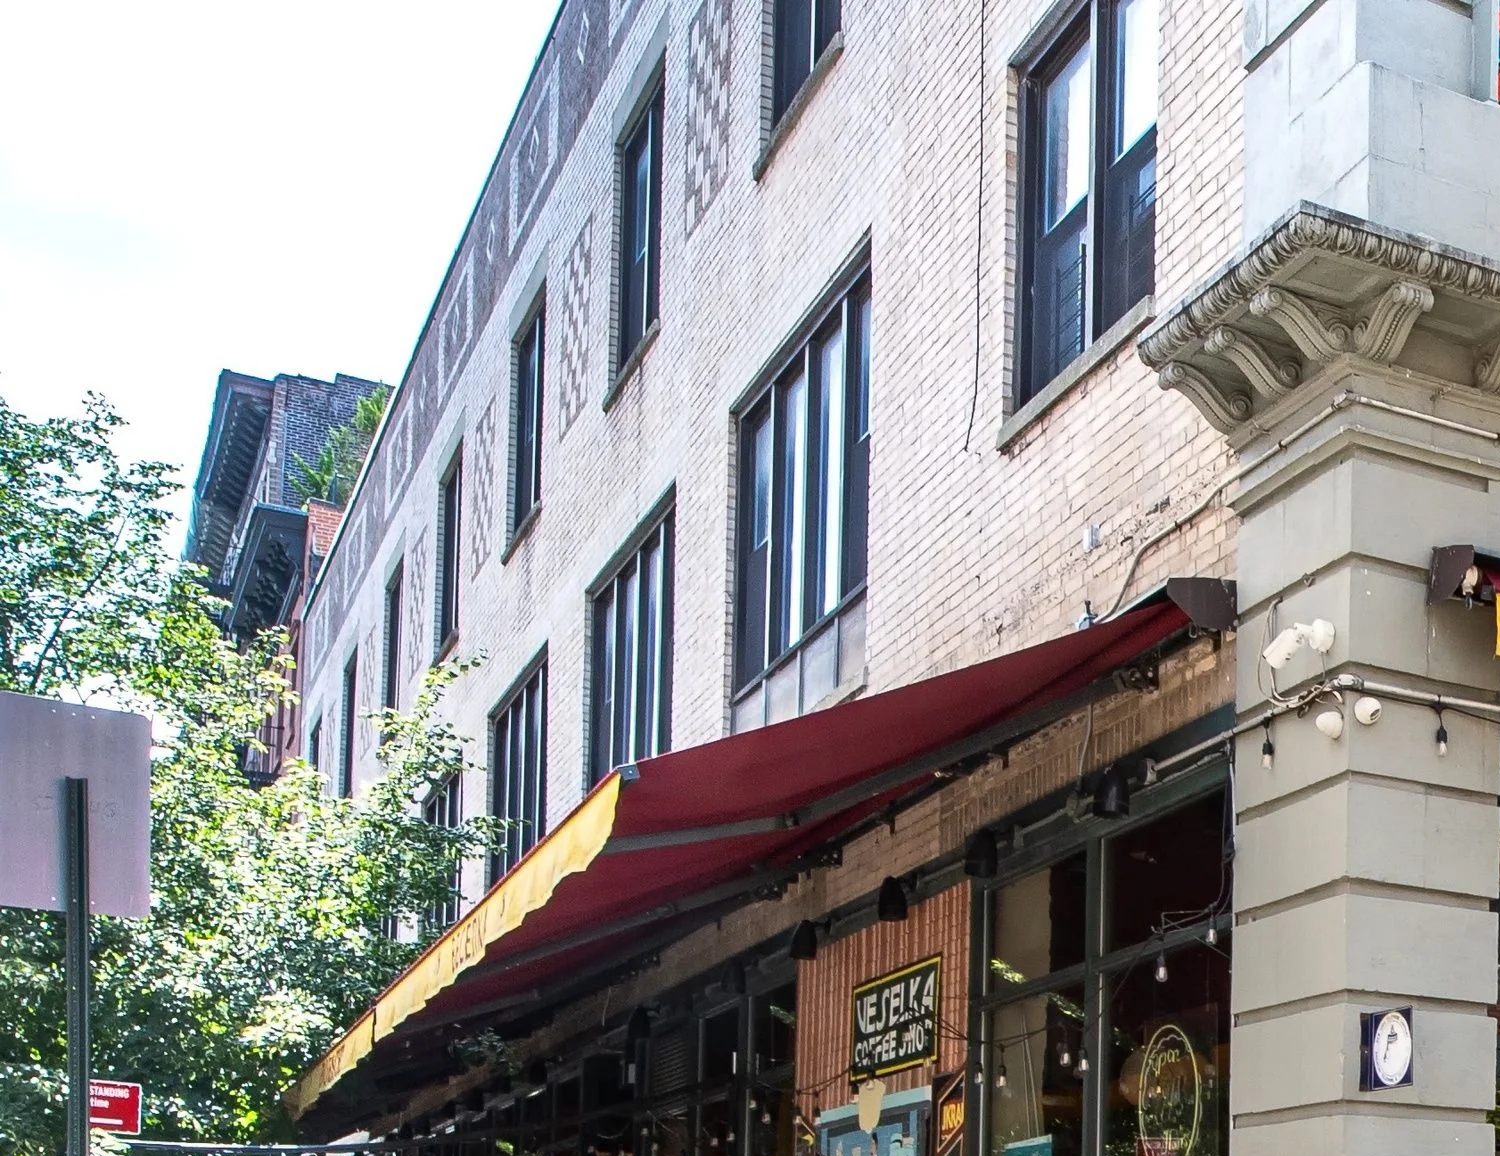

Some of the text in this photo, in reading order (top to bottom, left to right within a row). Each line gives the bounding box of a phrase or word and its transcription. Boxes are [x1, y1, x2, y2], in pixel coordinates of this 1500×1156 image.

[857, 970, 937, 1034] VESELKA
[855, 1030, 897, 1067] COFFEE
[90, 1085, 130, 1098] STANDING
